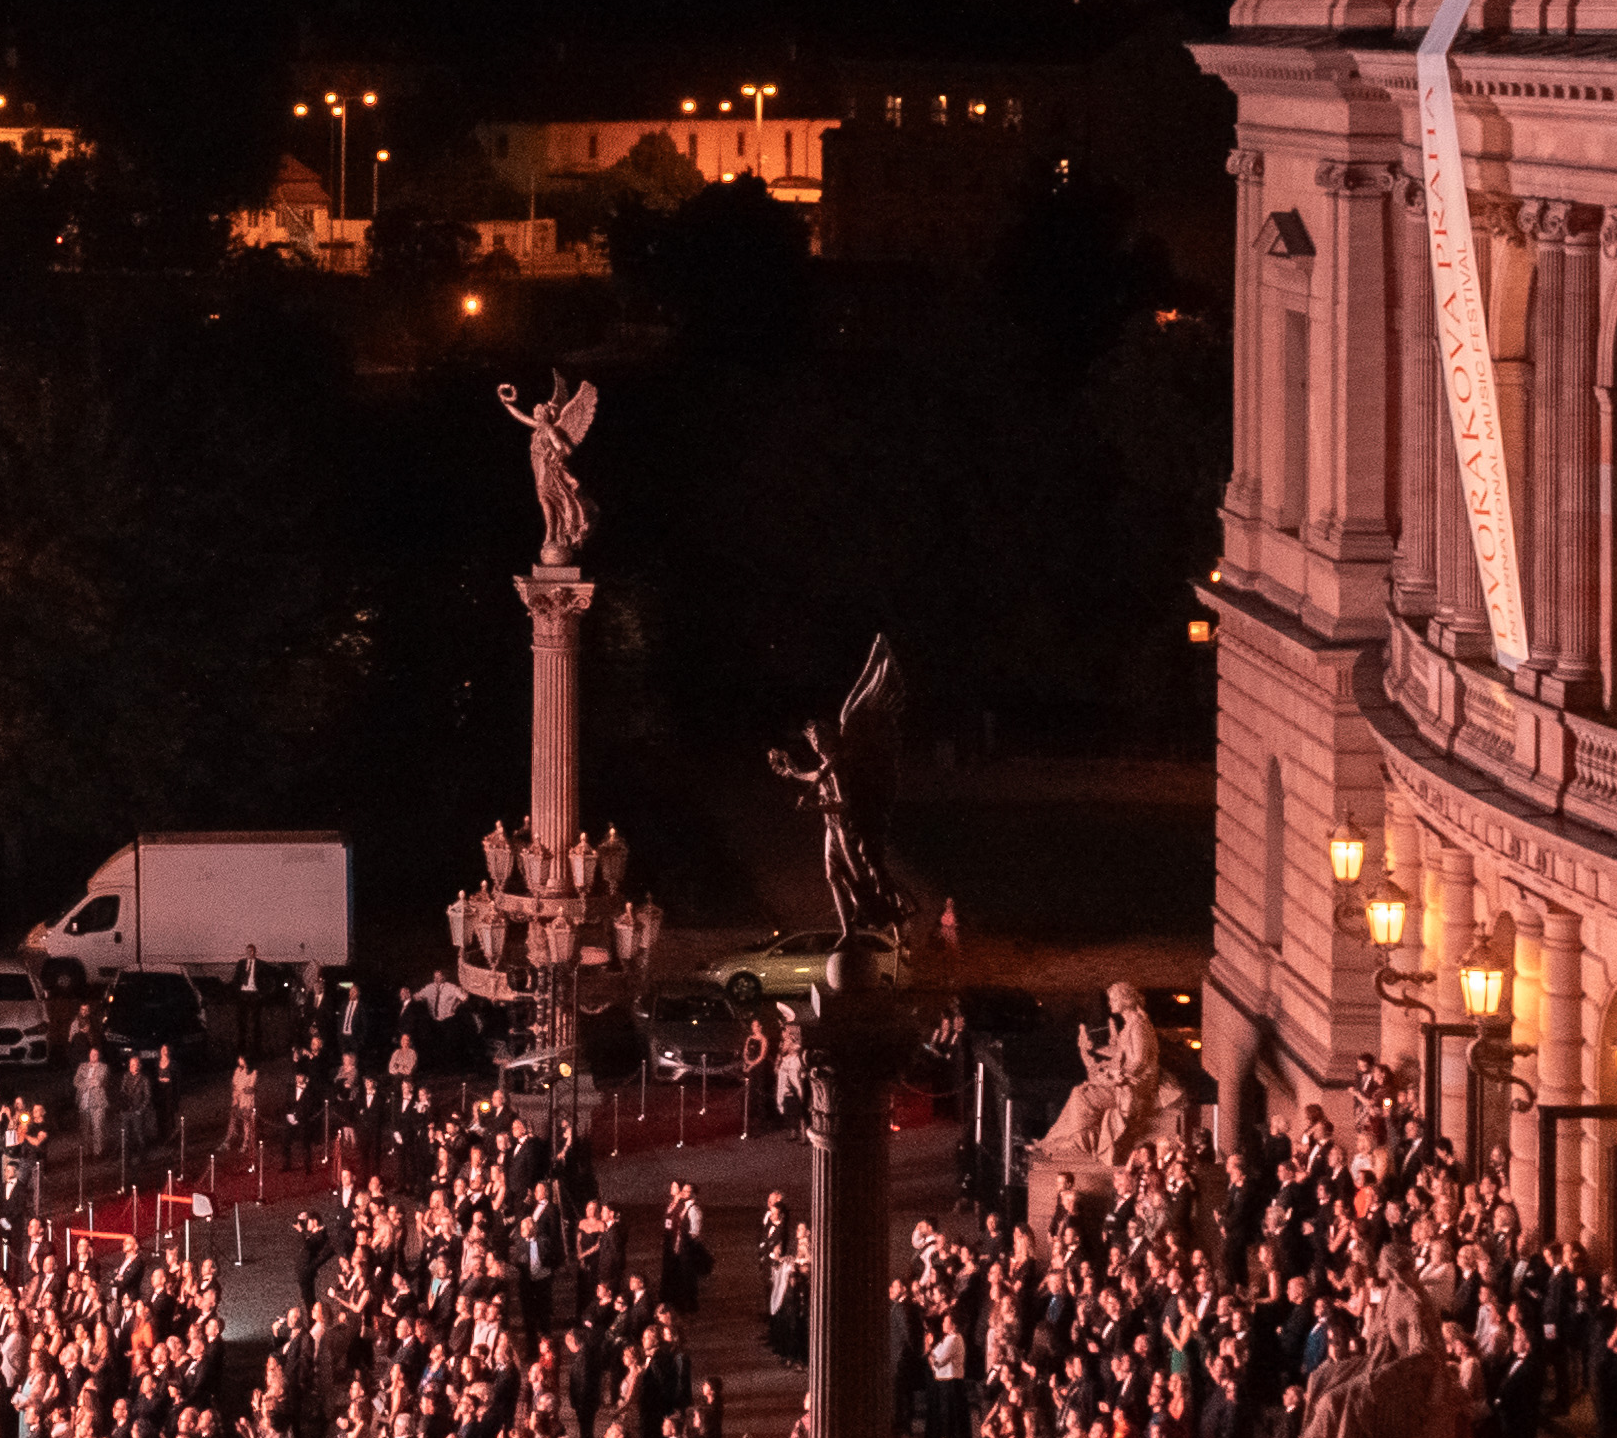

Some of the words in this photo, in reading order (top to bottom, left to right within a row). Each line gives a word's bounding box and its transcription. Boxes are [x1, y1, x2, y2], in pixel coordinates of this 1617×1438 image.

[1424, 87, 1452, 269] PRAHA
[1456, 241, 1482, 353] FESTIVAL
[1474, 360, 1496, 440] MUSIC
[1489, 445, 1519, 644] INTERNATIONAL
